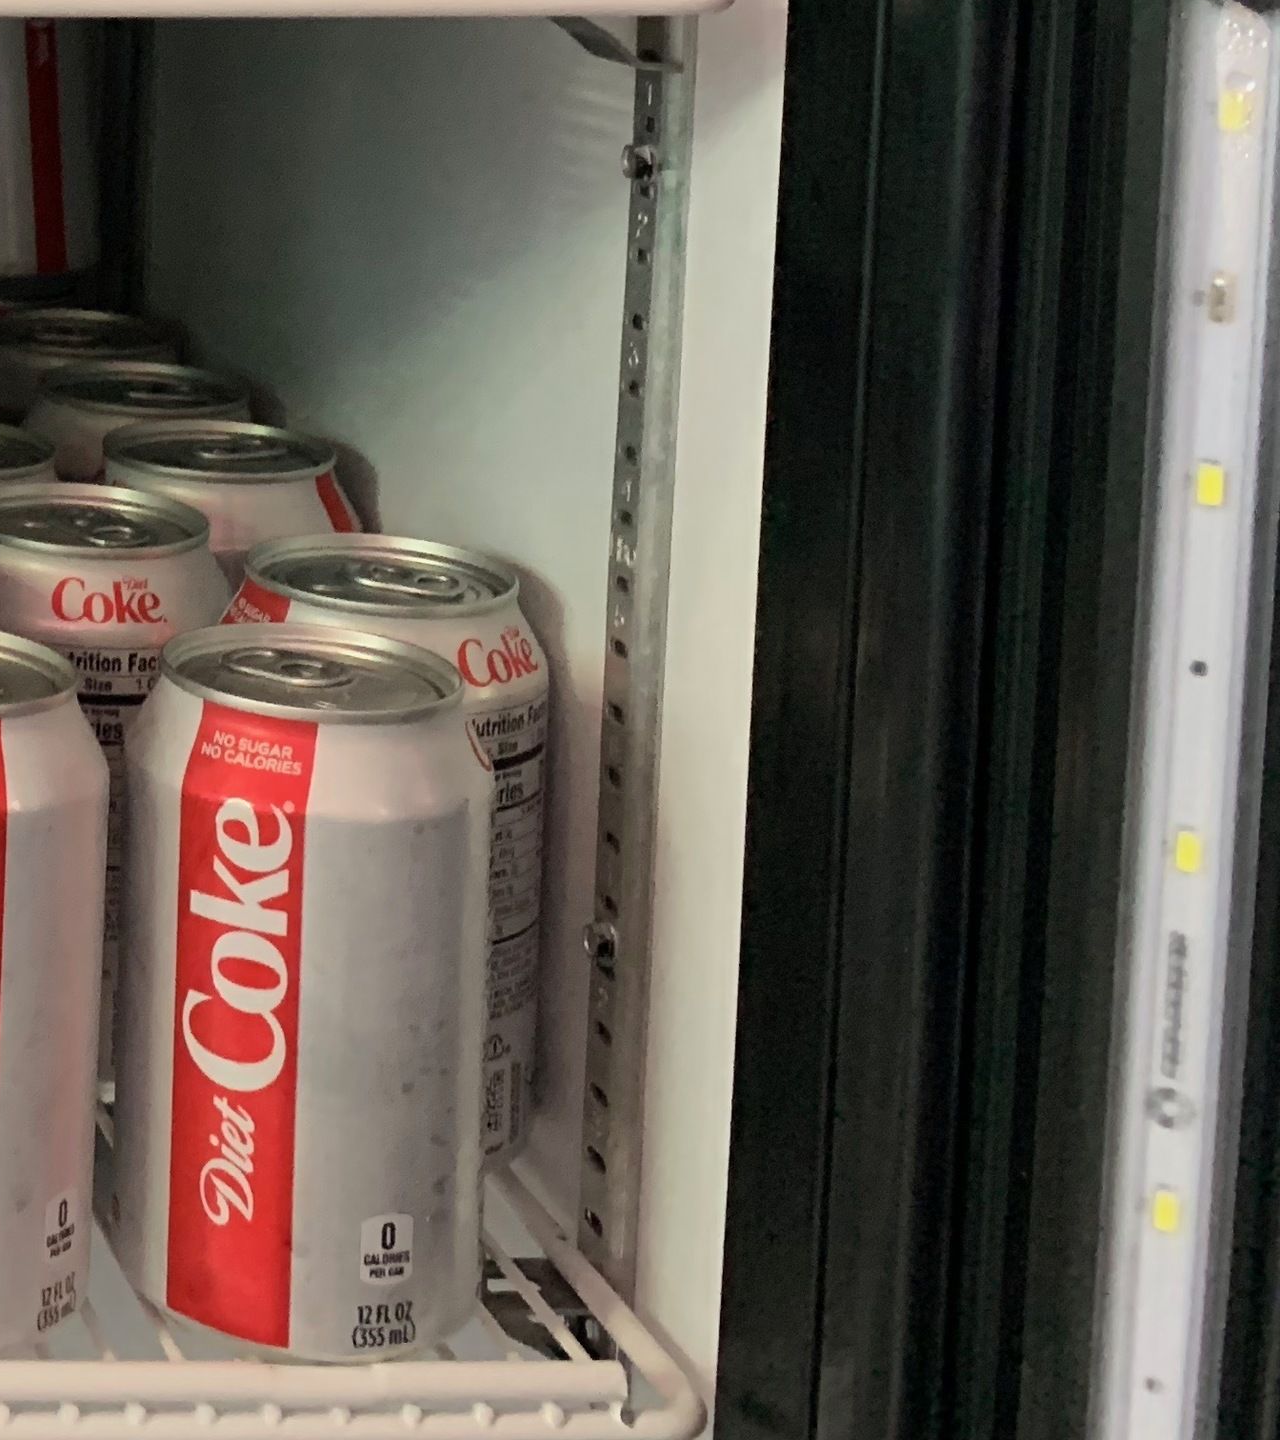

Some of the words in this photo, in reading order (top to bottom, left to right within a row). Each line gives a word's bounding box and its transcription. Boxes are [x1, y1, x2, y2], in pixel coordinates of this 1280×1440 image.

[51, 577, 164, 624] Coke
[458, 634, 538, 687] Coke
[201, 741, 222, 759] NO
[224, 749, 302, 776] CALORIES
[213, 729, 236, 748] NO
[238, 737, 293, 760] SUGAR
[182, 796, 294, 1093] Coke
[200, 1095, 260, 1227] Diet
[58, 1198, 68, 1227] 0
[381, 1222, 396, 1250] 0
[41, 1286, 52, 1307] 12
[357, 1305, 372, 1325] 12
[376, 1304, 391, 1324] FL
[395, 1300, 413, 1322] OZ
[352, 1325, 385, 1348] (355
